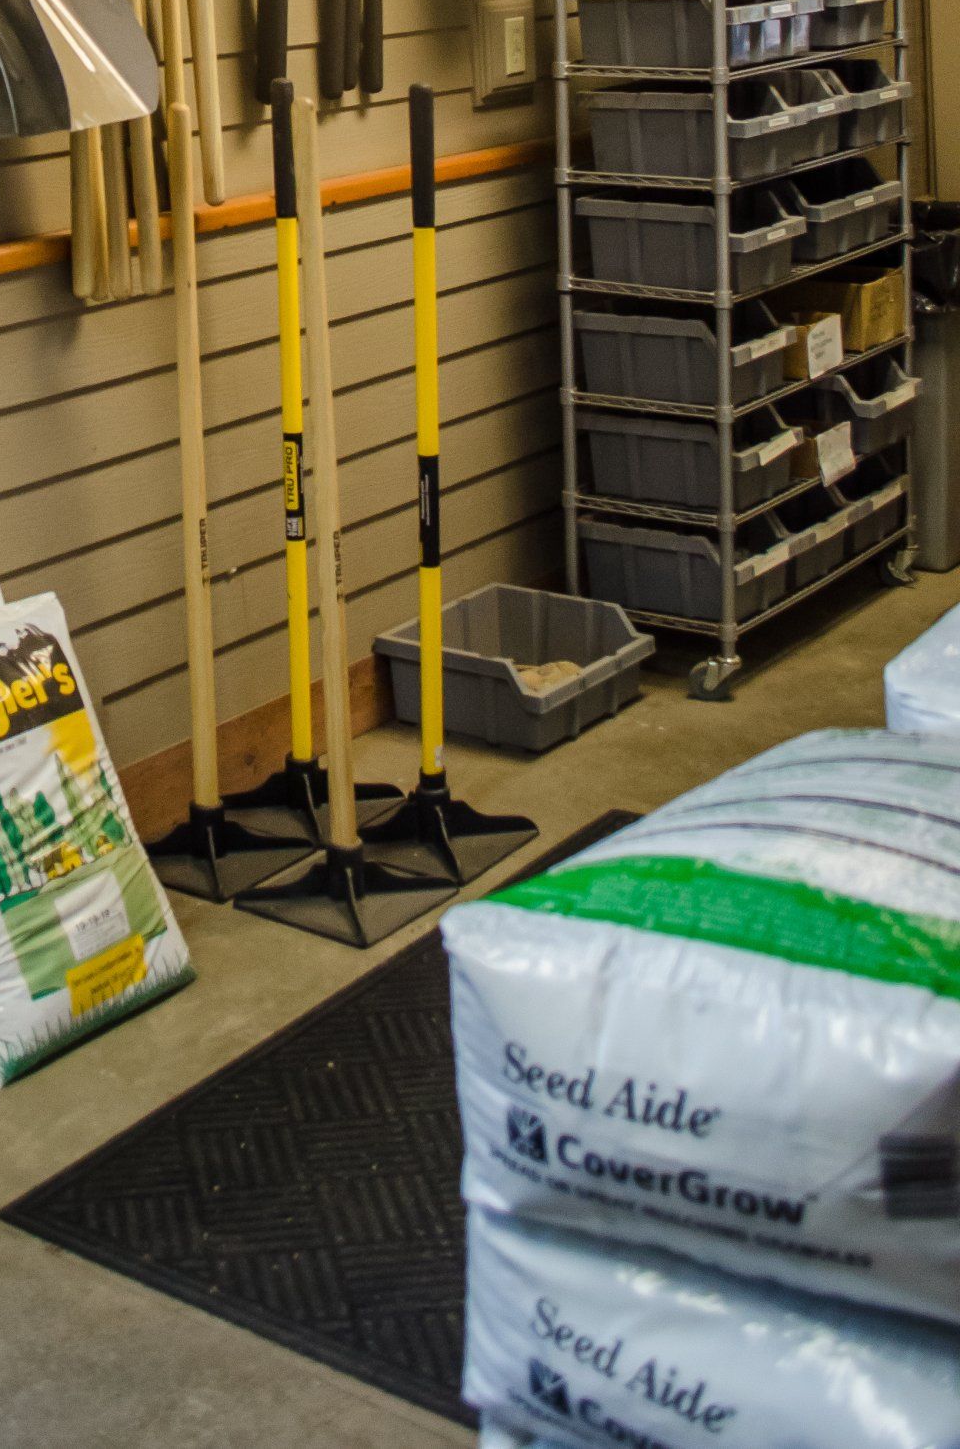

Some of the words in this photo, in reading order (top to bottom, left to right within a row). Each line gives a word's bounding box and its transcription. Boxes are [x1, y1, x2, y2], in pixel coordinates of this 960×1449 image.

[285, 446, 293, 475] PRO
[287, 478, 295, 503] TRU
[502, 1041, 596, 1111] Seed
[603, 1076, 714, 1139] Aide
[556, 1132, 808, 1226] CoverGrow
[530, 1296, 623, 1379] Seed
[625, 1357, 728, 1435] Aide
